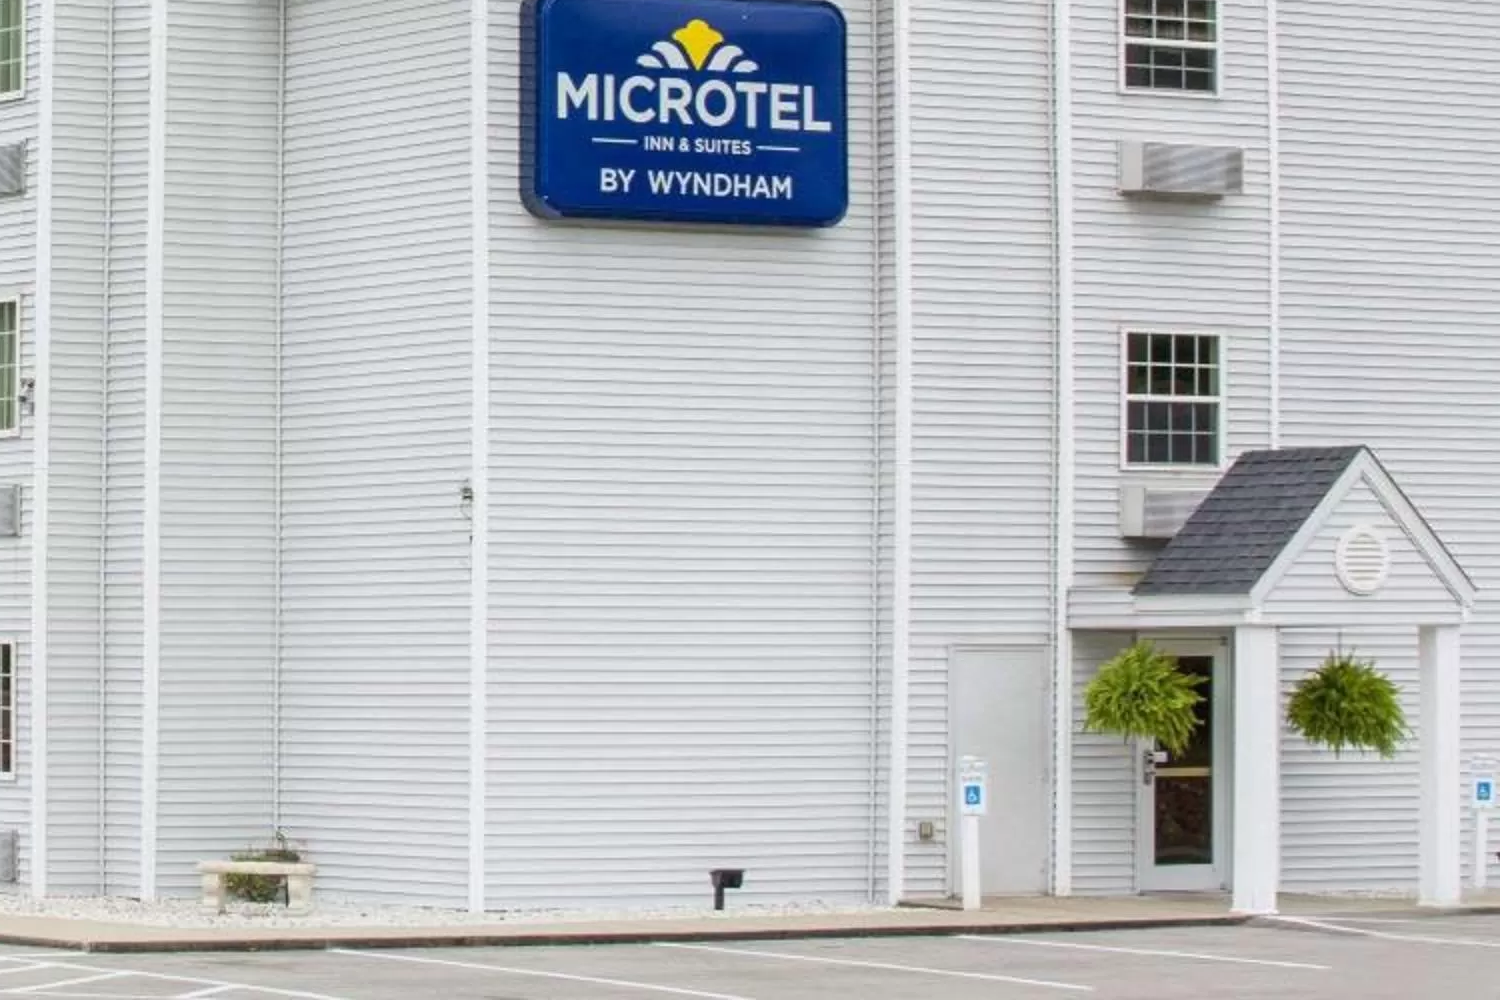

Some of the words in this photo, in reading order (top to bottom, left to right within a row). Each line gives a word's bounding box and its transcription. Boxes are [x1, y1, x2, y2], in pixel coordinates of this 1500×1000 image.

[556, 71, 832, 132] MICROTEL
[644, 136, 674, 152] INN
[679, 137, 689, 152] &
[695, 138, 751, 155] SUITES
[600, 168, 636, 193] BY
[648, 169, 793, 200] WYNDHAM
